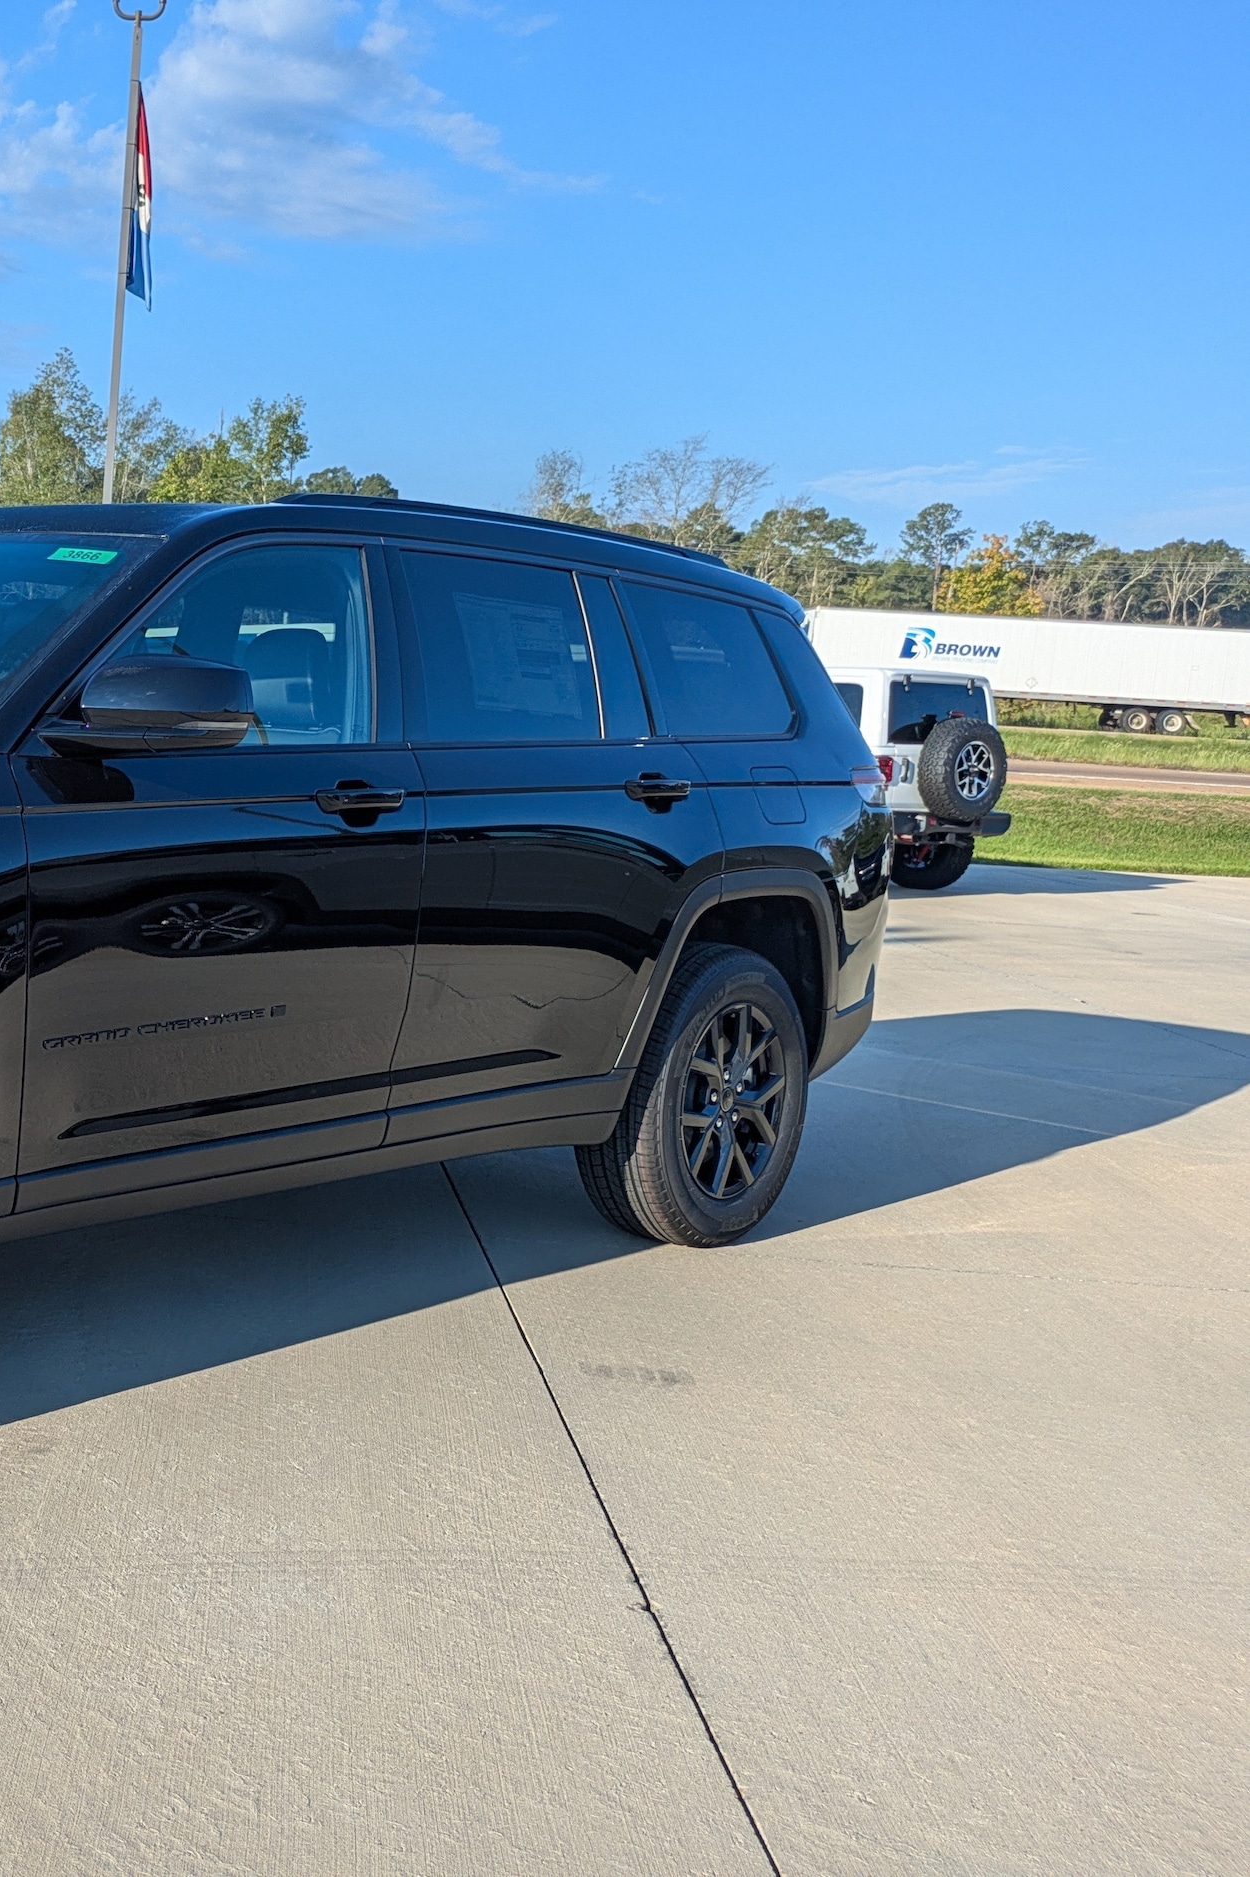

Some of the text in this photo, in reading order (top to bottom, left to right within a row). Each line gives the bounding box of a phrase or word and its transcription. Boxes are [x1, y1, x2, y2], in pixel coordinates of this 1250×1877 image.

[62, 550, 103, 561] 3866
[934, 642, 1001, 658] BROWN
[42, 1027, 131, 1049] GRAND
[137, 1007, 266, 1036] CHEROKEE
